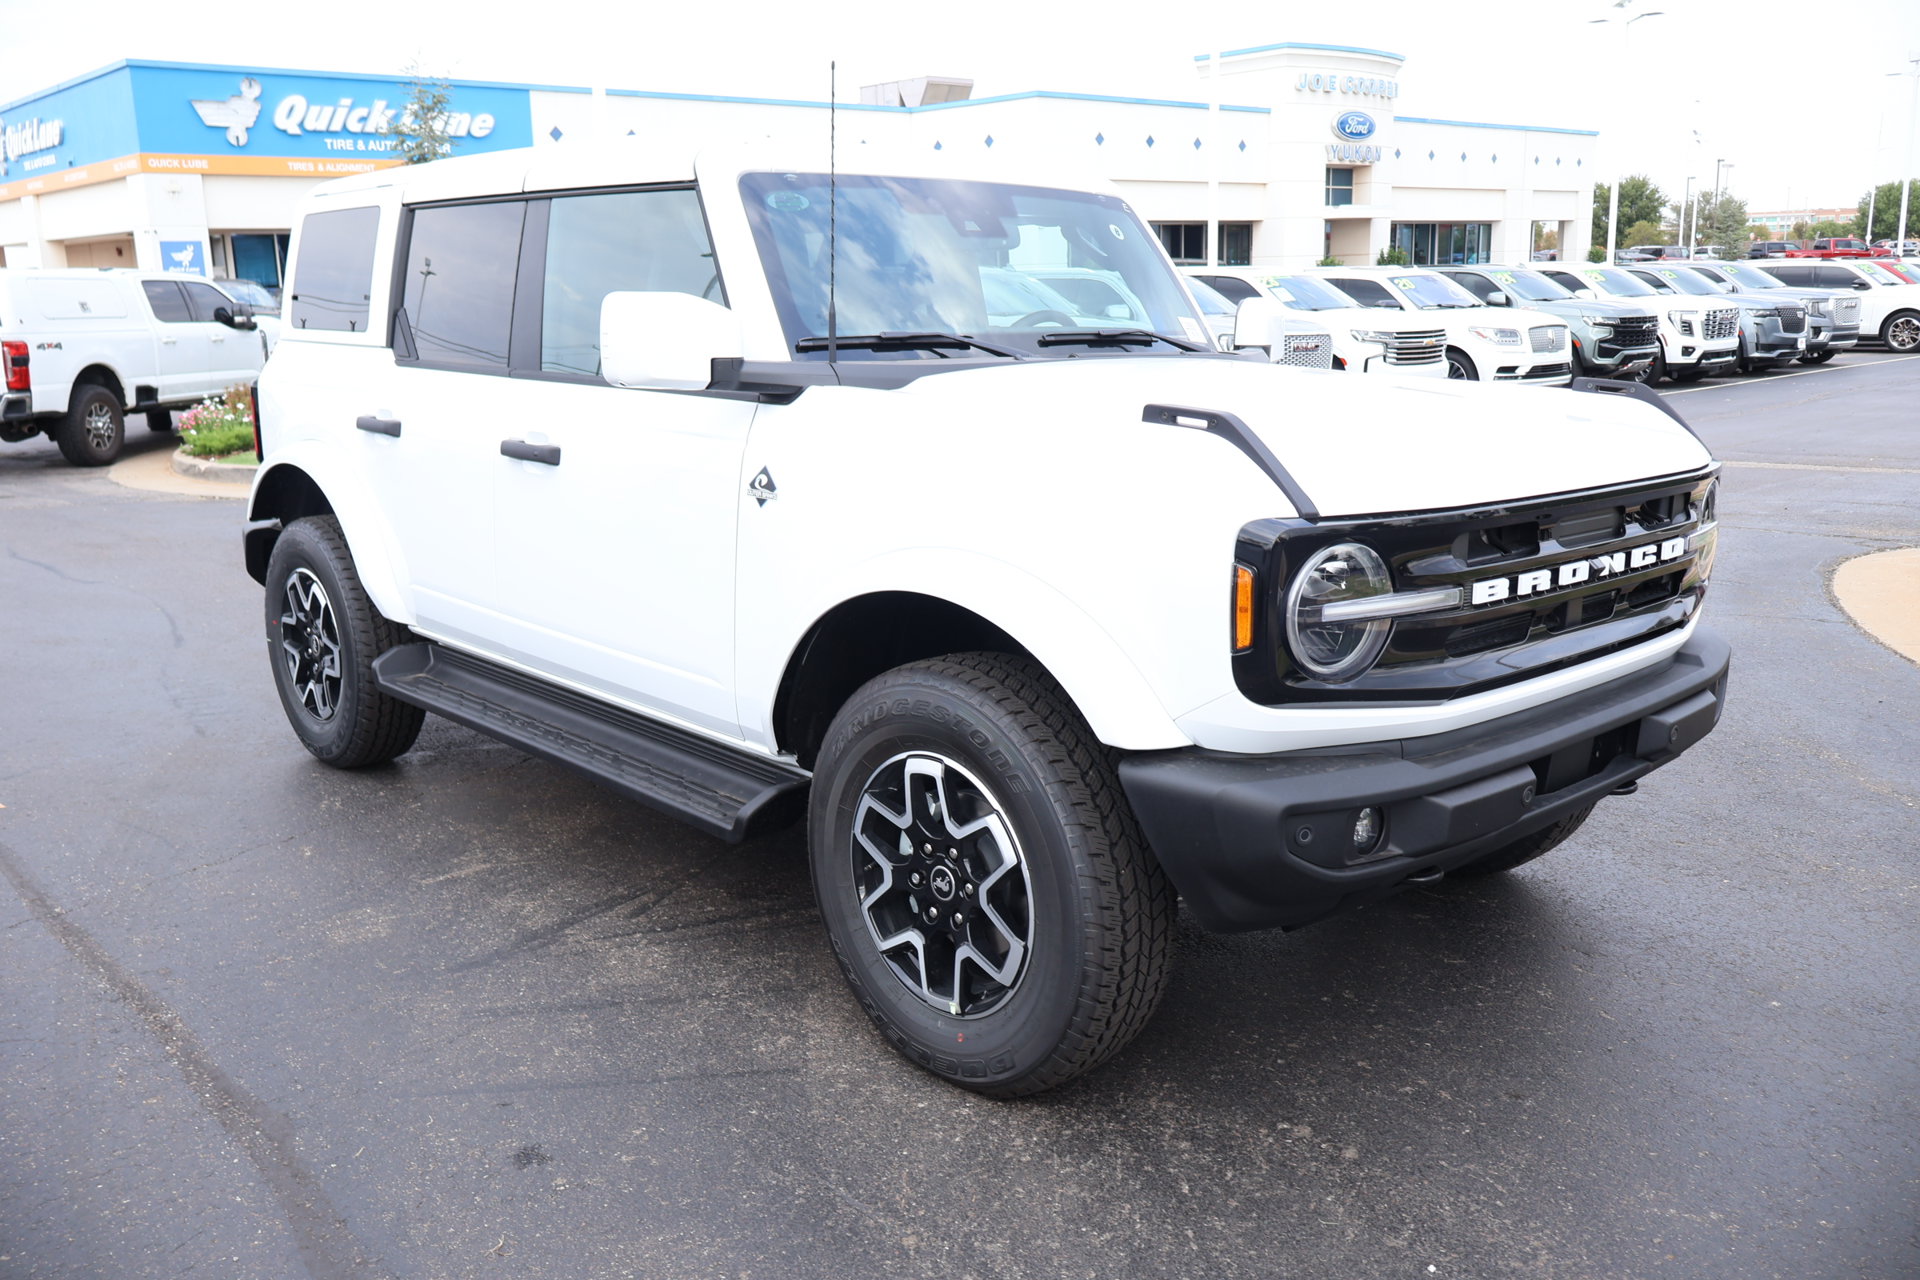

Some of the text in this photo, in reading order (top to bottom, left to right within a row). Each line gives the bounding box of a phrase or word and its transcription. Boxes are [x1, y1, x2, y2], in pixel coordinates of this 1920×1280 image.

[1296, 73, 1337, 92] JOE
[273, 94, 396, 135] Quick
[1345, 116, 1369, 134] Ford
[324, 138, 354, 151] TIRE
[356, 139, 366, 151] &
[1327, 145, 1382, 162] YUKON
[148, 158, 181, 169] QUICK
[182, 159, 209, 169] LUBE
[287, 161, 315, 172] TIRES
[326, 163, 376, 173] ALIGNMENT
[1471, 536, 1685, 605] BRONCO
[832, 698, 1031, 794] BRIDGESTONE
